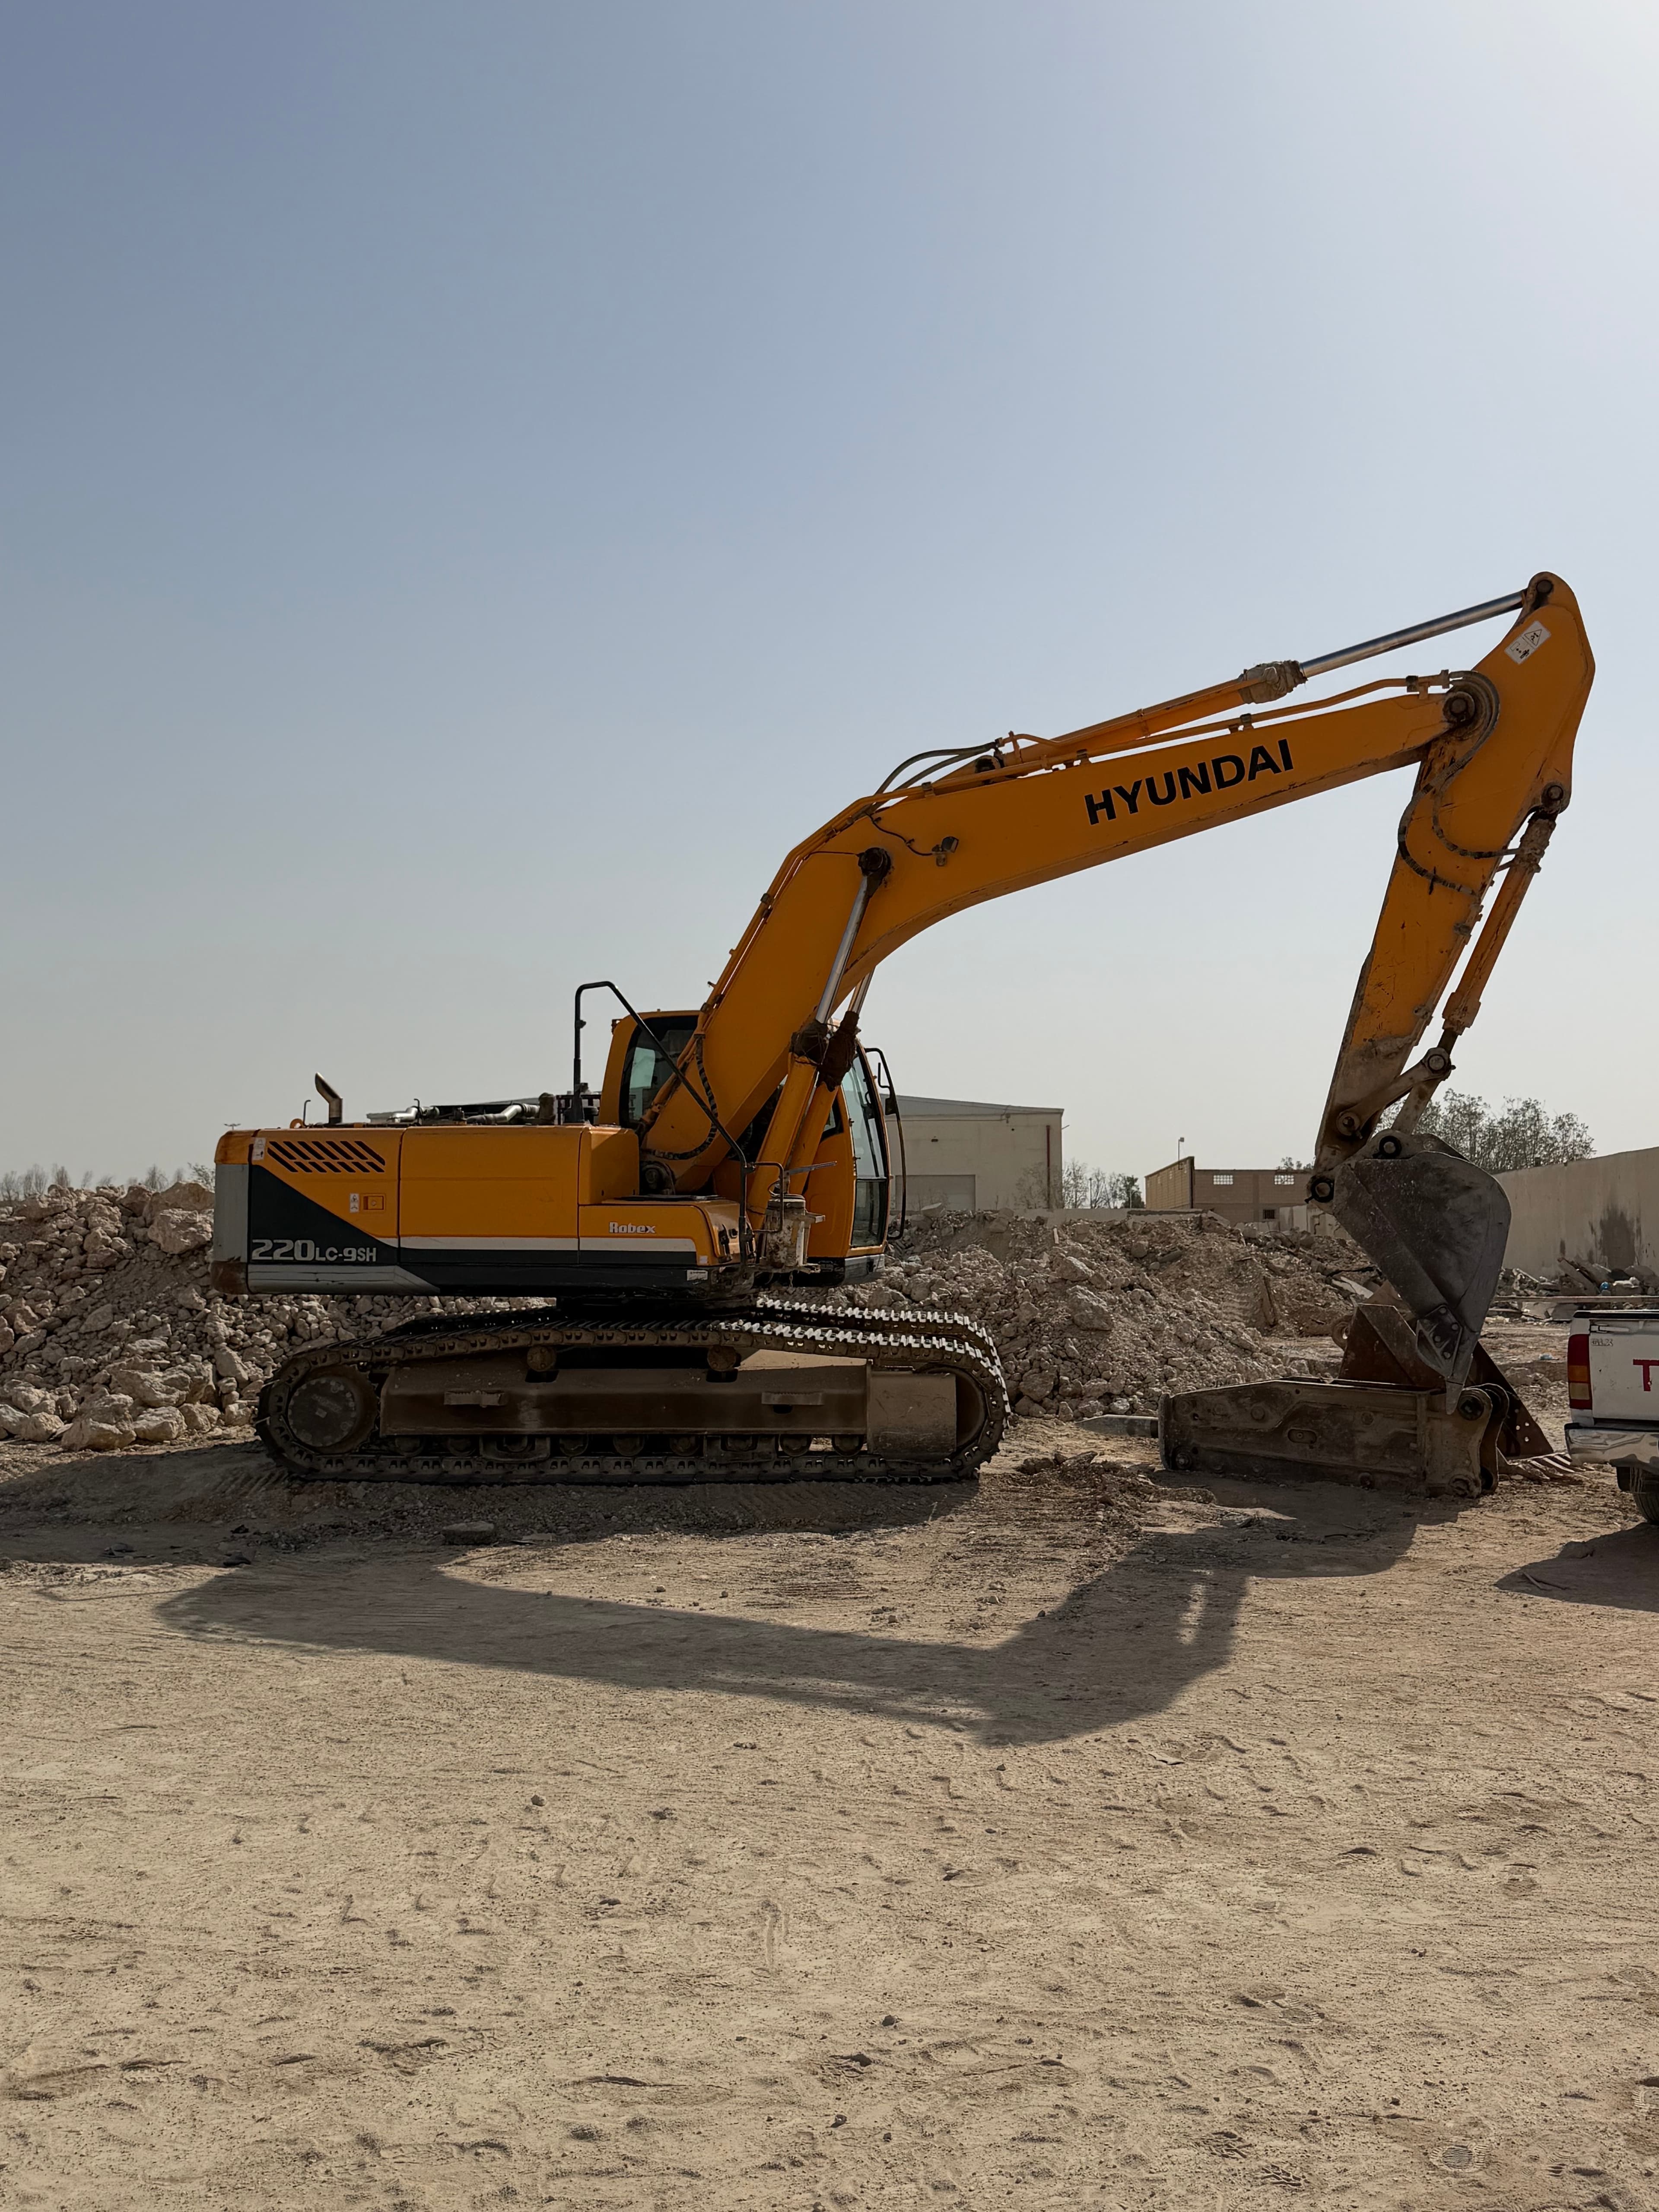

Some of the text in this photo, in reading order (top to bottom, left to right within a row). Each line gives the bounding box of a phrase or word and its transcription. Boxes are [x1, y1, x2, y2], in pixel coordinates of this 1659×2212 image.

[1084, 738, 1294, 825] HYUNDAI
[609, 1222, 656, 1233] Robex
[252, 1239, 376, 1262] 220LC-9SH
